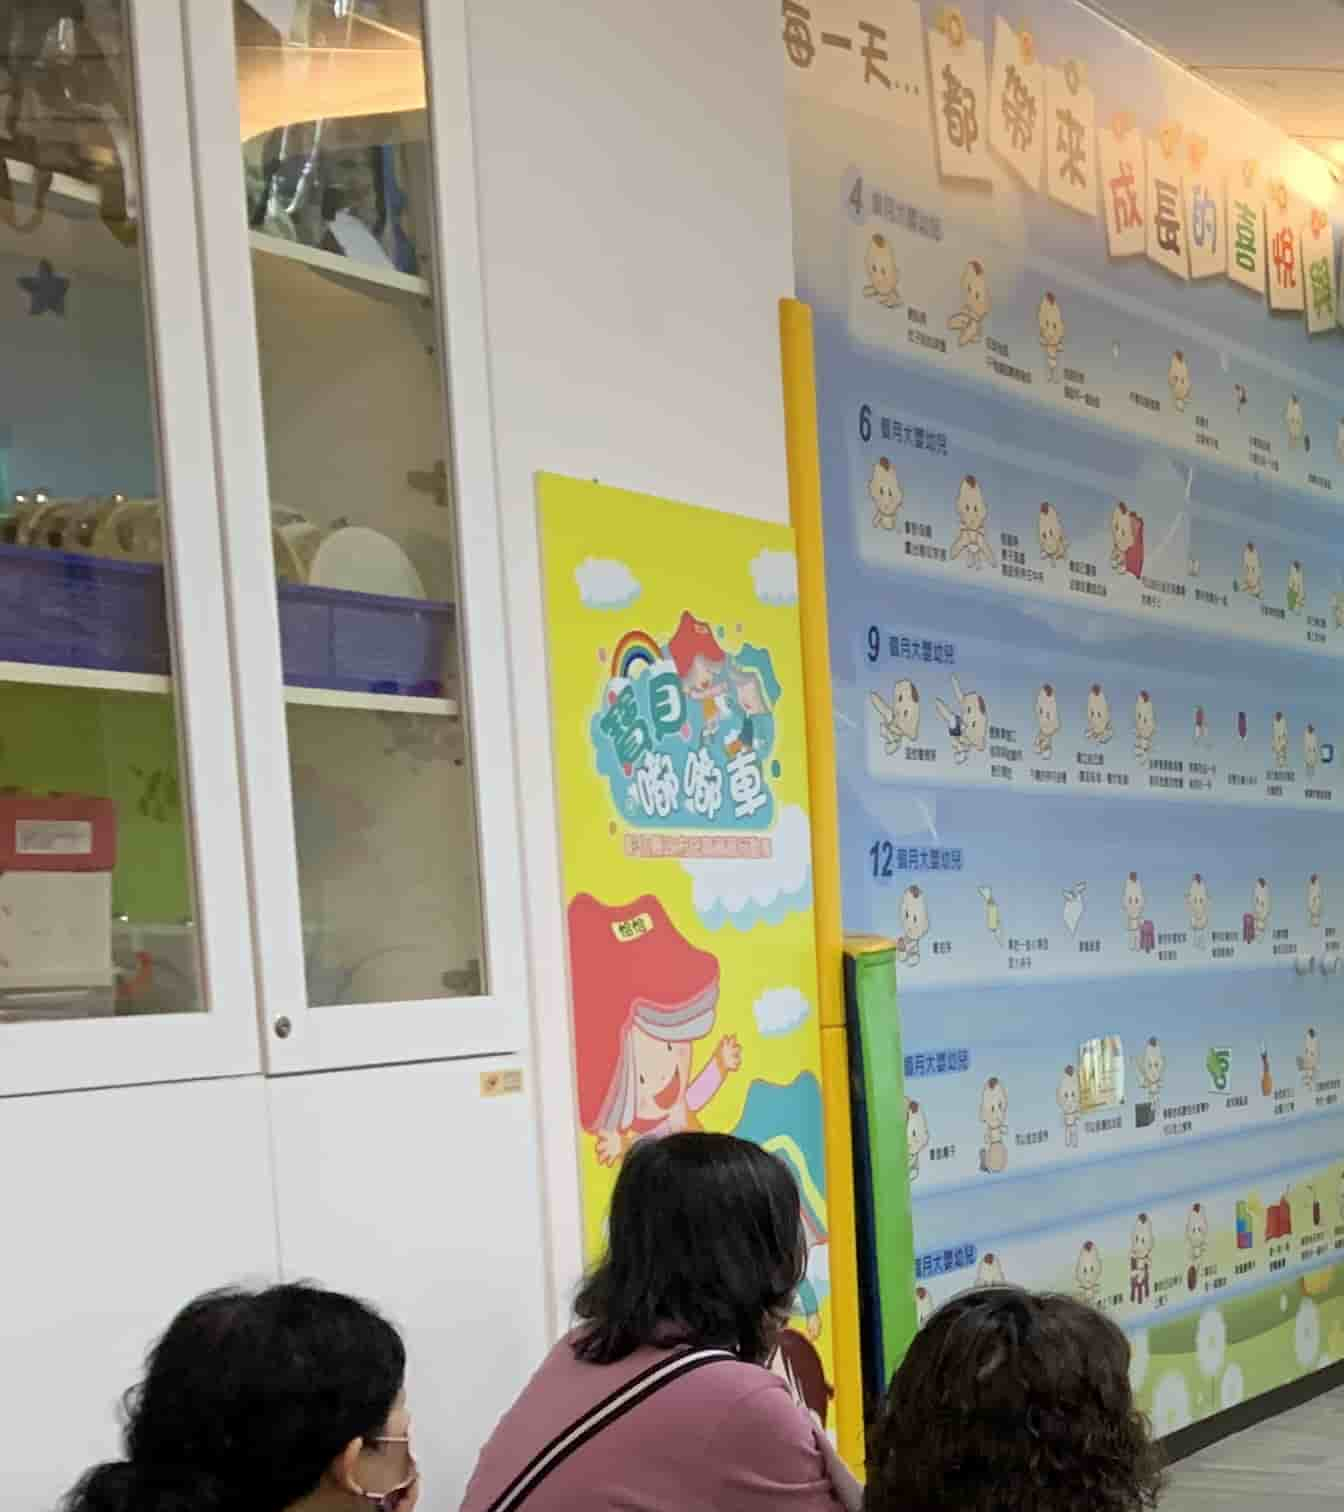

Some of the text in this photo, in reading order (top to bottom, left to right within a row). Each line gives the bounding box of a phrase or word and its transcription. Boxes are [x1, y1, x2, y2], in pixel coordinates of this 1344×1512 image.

[849, 176, 864, 215] 4
[858, 403, 873, 443] 6
[867, 625, 881, 663] 9
[869, 840, 894, 878] 12
